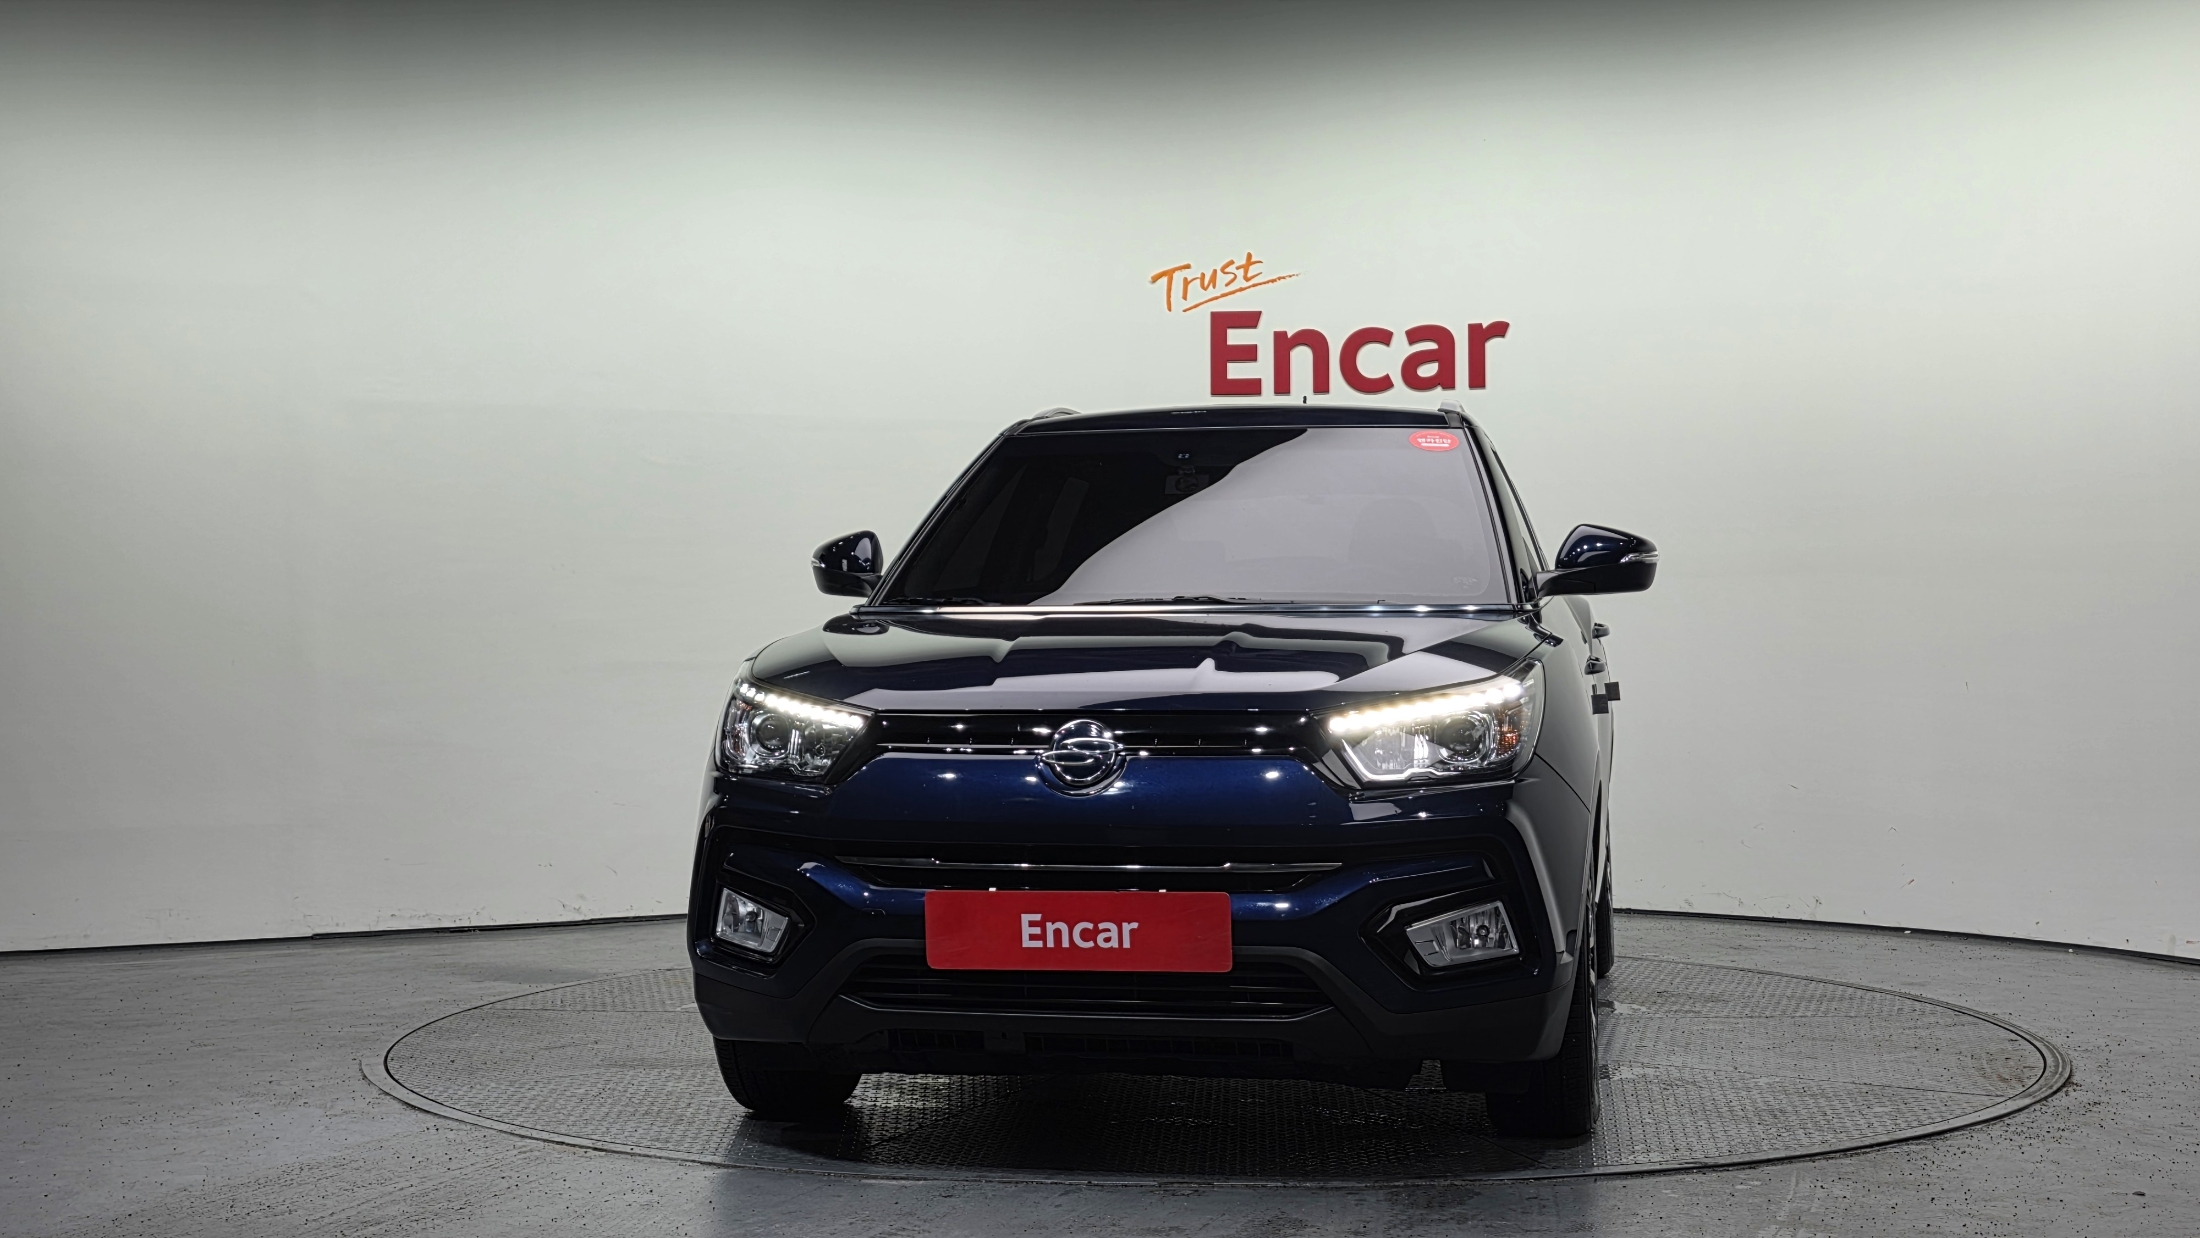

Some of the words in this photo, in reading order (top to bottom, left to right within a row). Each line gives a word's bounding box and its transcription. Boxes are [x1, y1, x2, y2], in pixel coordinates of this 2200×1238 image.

[1149, 251, 1263, 312] Trust
[1209, 310, 1510, 395] Encar
[1020, 913, 1139, 949] Encar
